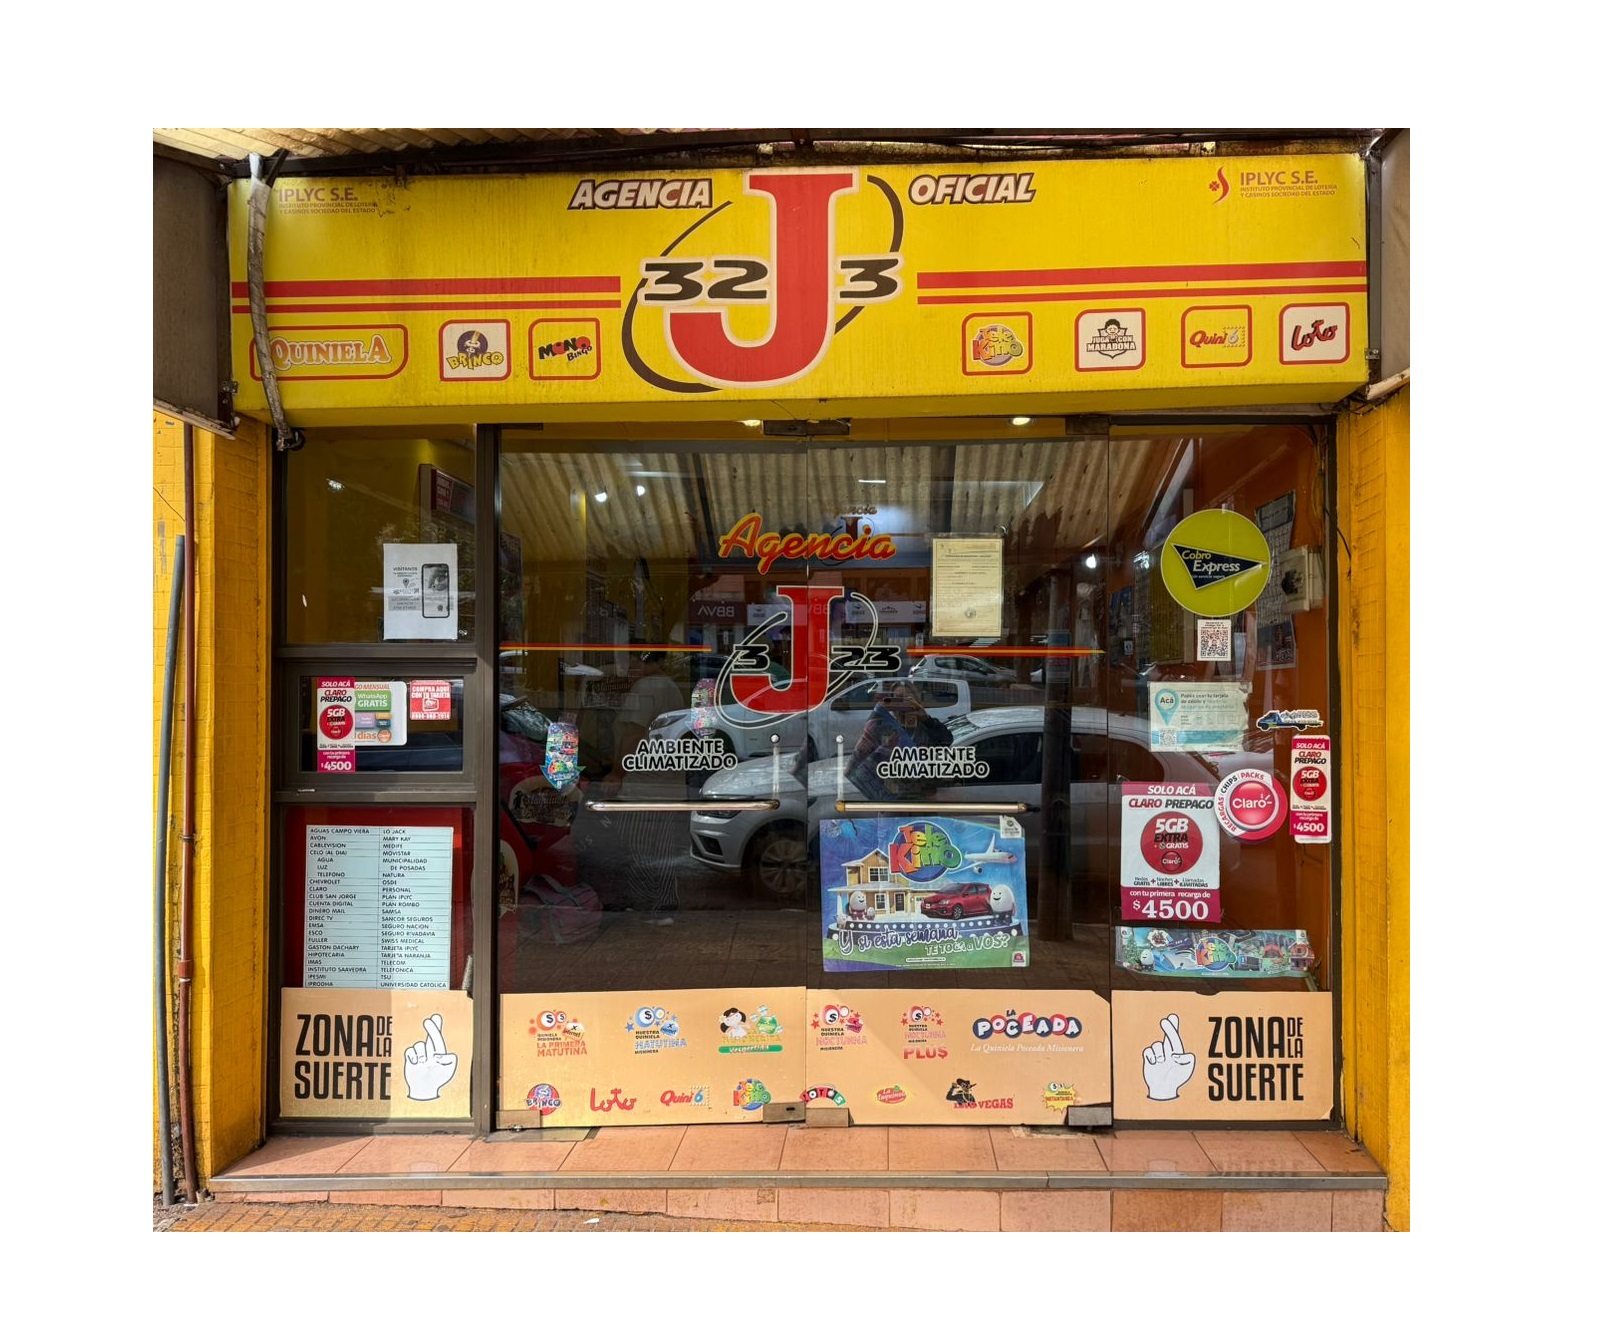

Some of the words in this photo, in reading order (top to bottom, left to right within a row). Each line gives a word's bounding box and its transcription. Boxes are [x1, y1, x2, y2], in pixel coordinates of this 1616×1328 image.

[1240, 172, 1286, 185] IPLYC
[1291, 170, 1318, 184] S.E.
[280, 188, 325, 201] IPLYC
[330, 187, 358, 201] S.E.
[567, 178, 713, 210] AGENCIA
[909, 172, 1036, 205] OFICIAL
[1087, 342, 1136, 352] MARADONA
[1190, 330, 1228, 347] Quini
[1228, 329, 1239, 344] 6
[270, 334, 392, 370] QUINIELA
[538, 336, 592, 360] MONO
[568, 345, 593, 362] BINGO
[972, 338, 1024, 360] Kino
[446, 352, 504, 370] BRINCO
[719, 512, 896, 575] Agencia
[1182, 550, 1211, 559] Cobro
[1193, 560, 1240, 575] Express
[327, 708, 345, 716] 5GB
[637, 739, 724, 756] AMBIENTE
[890, 746, 976, 762] AMBIENTE
[622, 752, 737, 772] CLIMATIZADO
[877, 760, 990, 779] CLIMATIZADO
[1241, 772, 1264, 780] PACKS
[1301, 770, 1319, 778] 5GB
[1147, 786, 1175, 794] SOLO
[1176, 784, 1196, 794] ACÁ
[1221, 775, 1238, 794] CHIPS
[1129, 799, 1162, 808] CLARO
[1165, 799, 1214, 809] PREPAGO
[1232, 796, 1266, 809] Claro
[1218, 796, 1237, 832] RECARGAS
[1155, 818, 1189, 833] 5GB
[899, 825, 946, 848] Tele
[1154, 833, 1188, 842] EXTRA
[890, 842, 961, 874] Kino
[1133, 900, 1209, 920] $4500
[875, 928, 901, 949] esta
[906, 927, 958, 944] semana
[926, 945, 938, 955] TE
[973, 933, 1010, 950] VOS?
[376, 1016, 392, 1035] DE
[974, 1013, 1081, 1038] POCEADA
[1287, 1017, 1303, 1037] DE
[296, 1014, 374, 1056] ZONA
[635, 1038, 687, 1049] MATUTINA
[1208, 1016, 1284, 1058] ZONA
[376, 1037, 391, 1057] LA
[537, 1048, 587, 1057] MATUTINA
[982, 1043, 1014, 1054] Quiniela
[1016, 1044, 1045, 1052] Poceada
[1046, 1043, 1084, 1052] Misionera
[1288, 1039, 1303, 1058] LA
[295, 1060, 391, 1100] SUERTE
[1208, 1063, 1304, 1101] SUERTE
[526, 1098, 561, 1108] BRINCO
[660, 1090, 694, 1105] Quini
[694, 1089, 703, 1103] 6
[979, 1098, 1013, 1109] VEGAS
